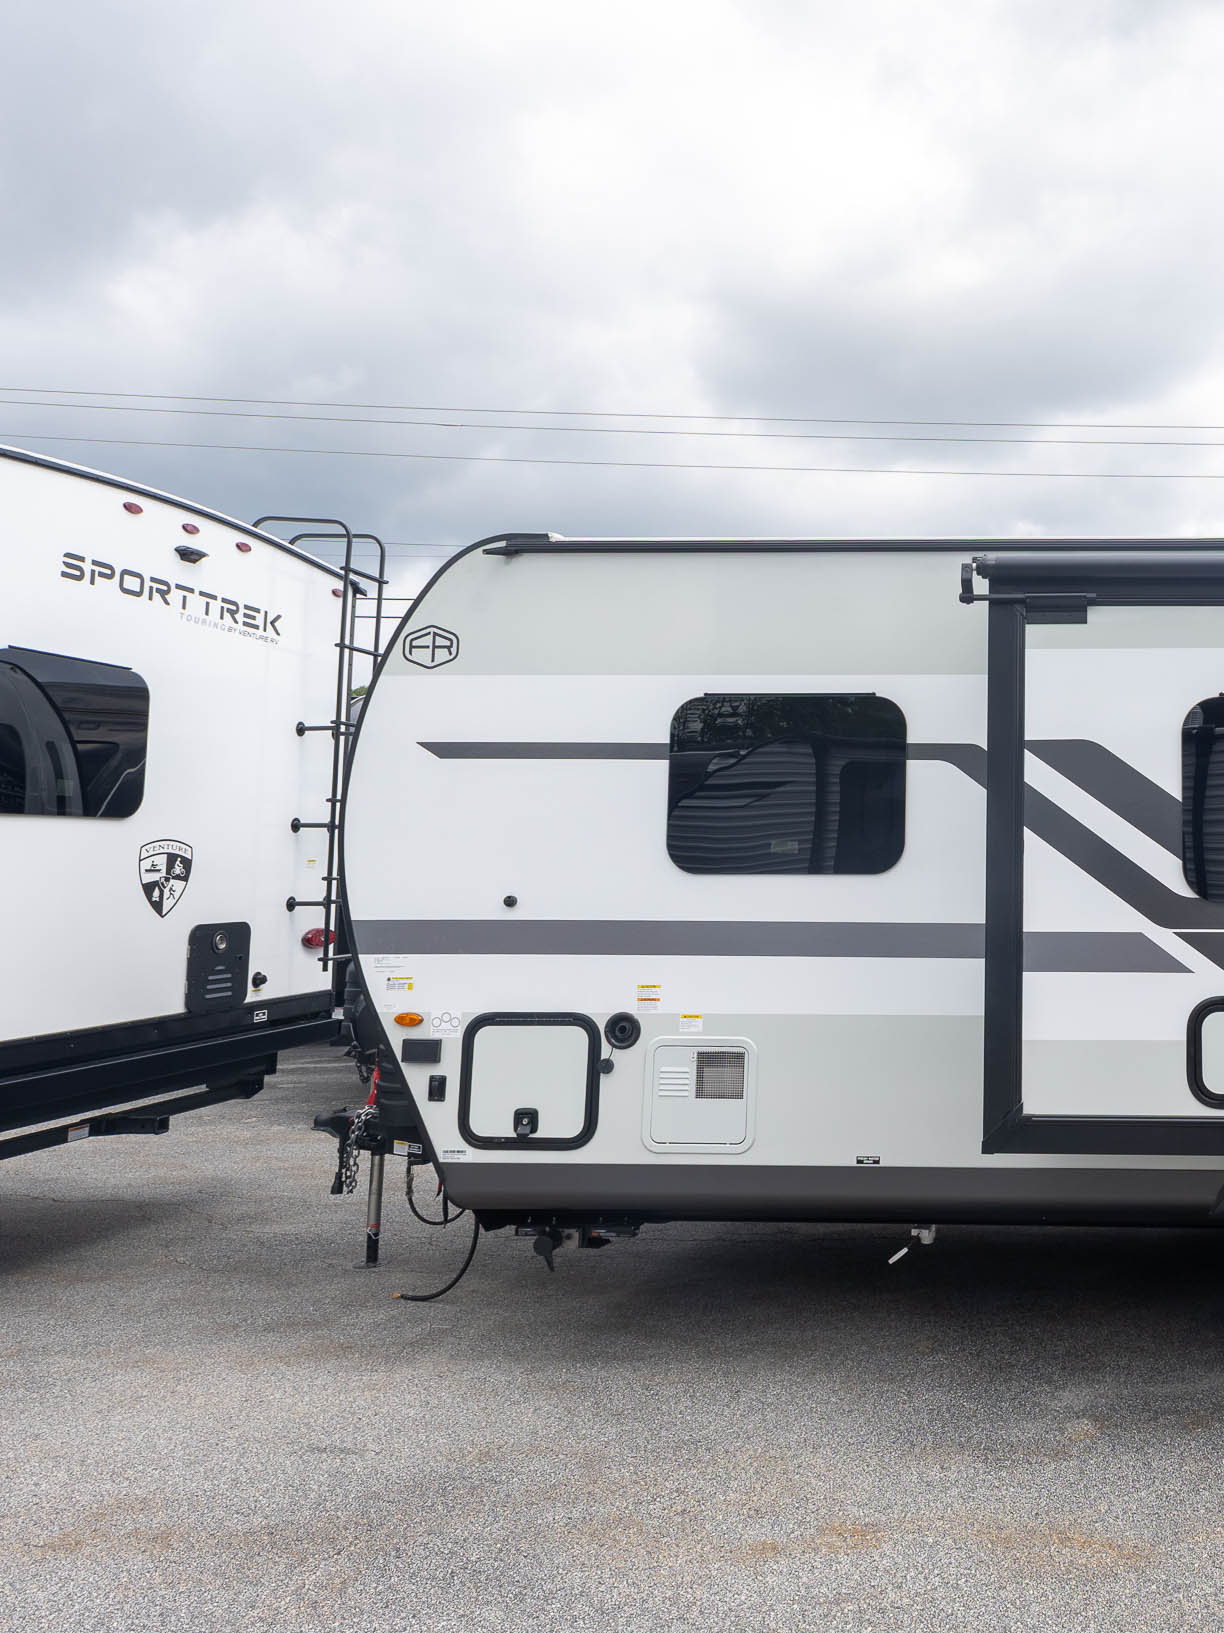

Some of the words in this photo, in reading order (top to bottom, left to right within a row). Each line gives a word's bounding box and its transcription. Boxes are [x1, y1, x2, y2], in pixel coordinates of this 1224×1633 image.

[60, 552, 283, 636] SPORTTREK
[180, 612, 227, 632] TOURING
[144, 843, 190, 856] VENTURE
